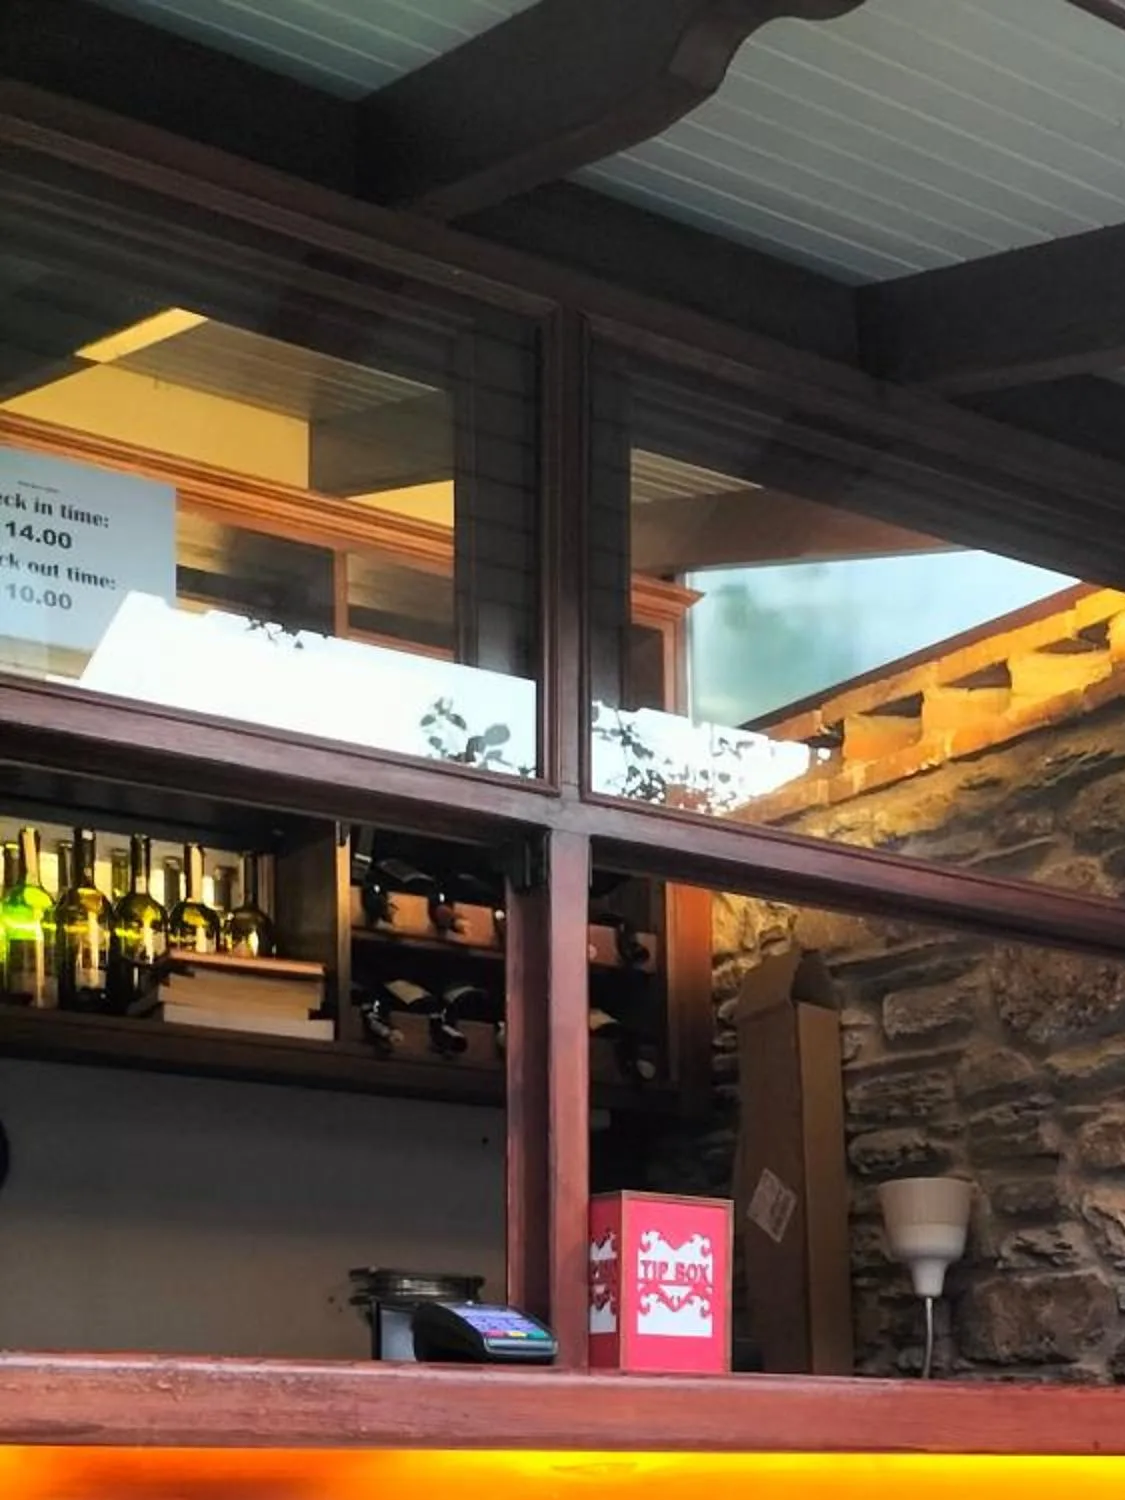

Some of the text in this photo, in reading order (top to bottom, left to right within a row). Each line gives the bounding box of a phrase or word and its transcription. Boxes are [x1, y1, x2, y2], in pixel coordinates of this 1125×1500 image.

[34, 497, 53, 515] in
[60, 504, 109, 528] time:
[5, 520, 72, 549] 14.00
[27, 561, 60, 578] out
[66, 567, 116, 590] time:
[5, 583, 72, 610] 10.00
[640, 1259, 711, 1284] TIP BOX
